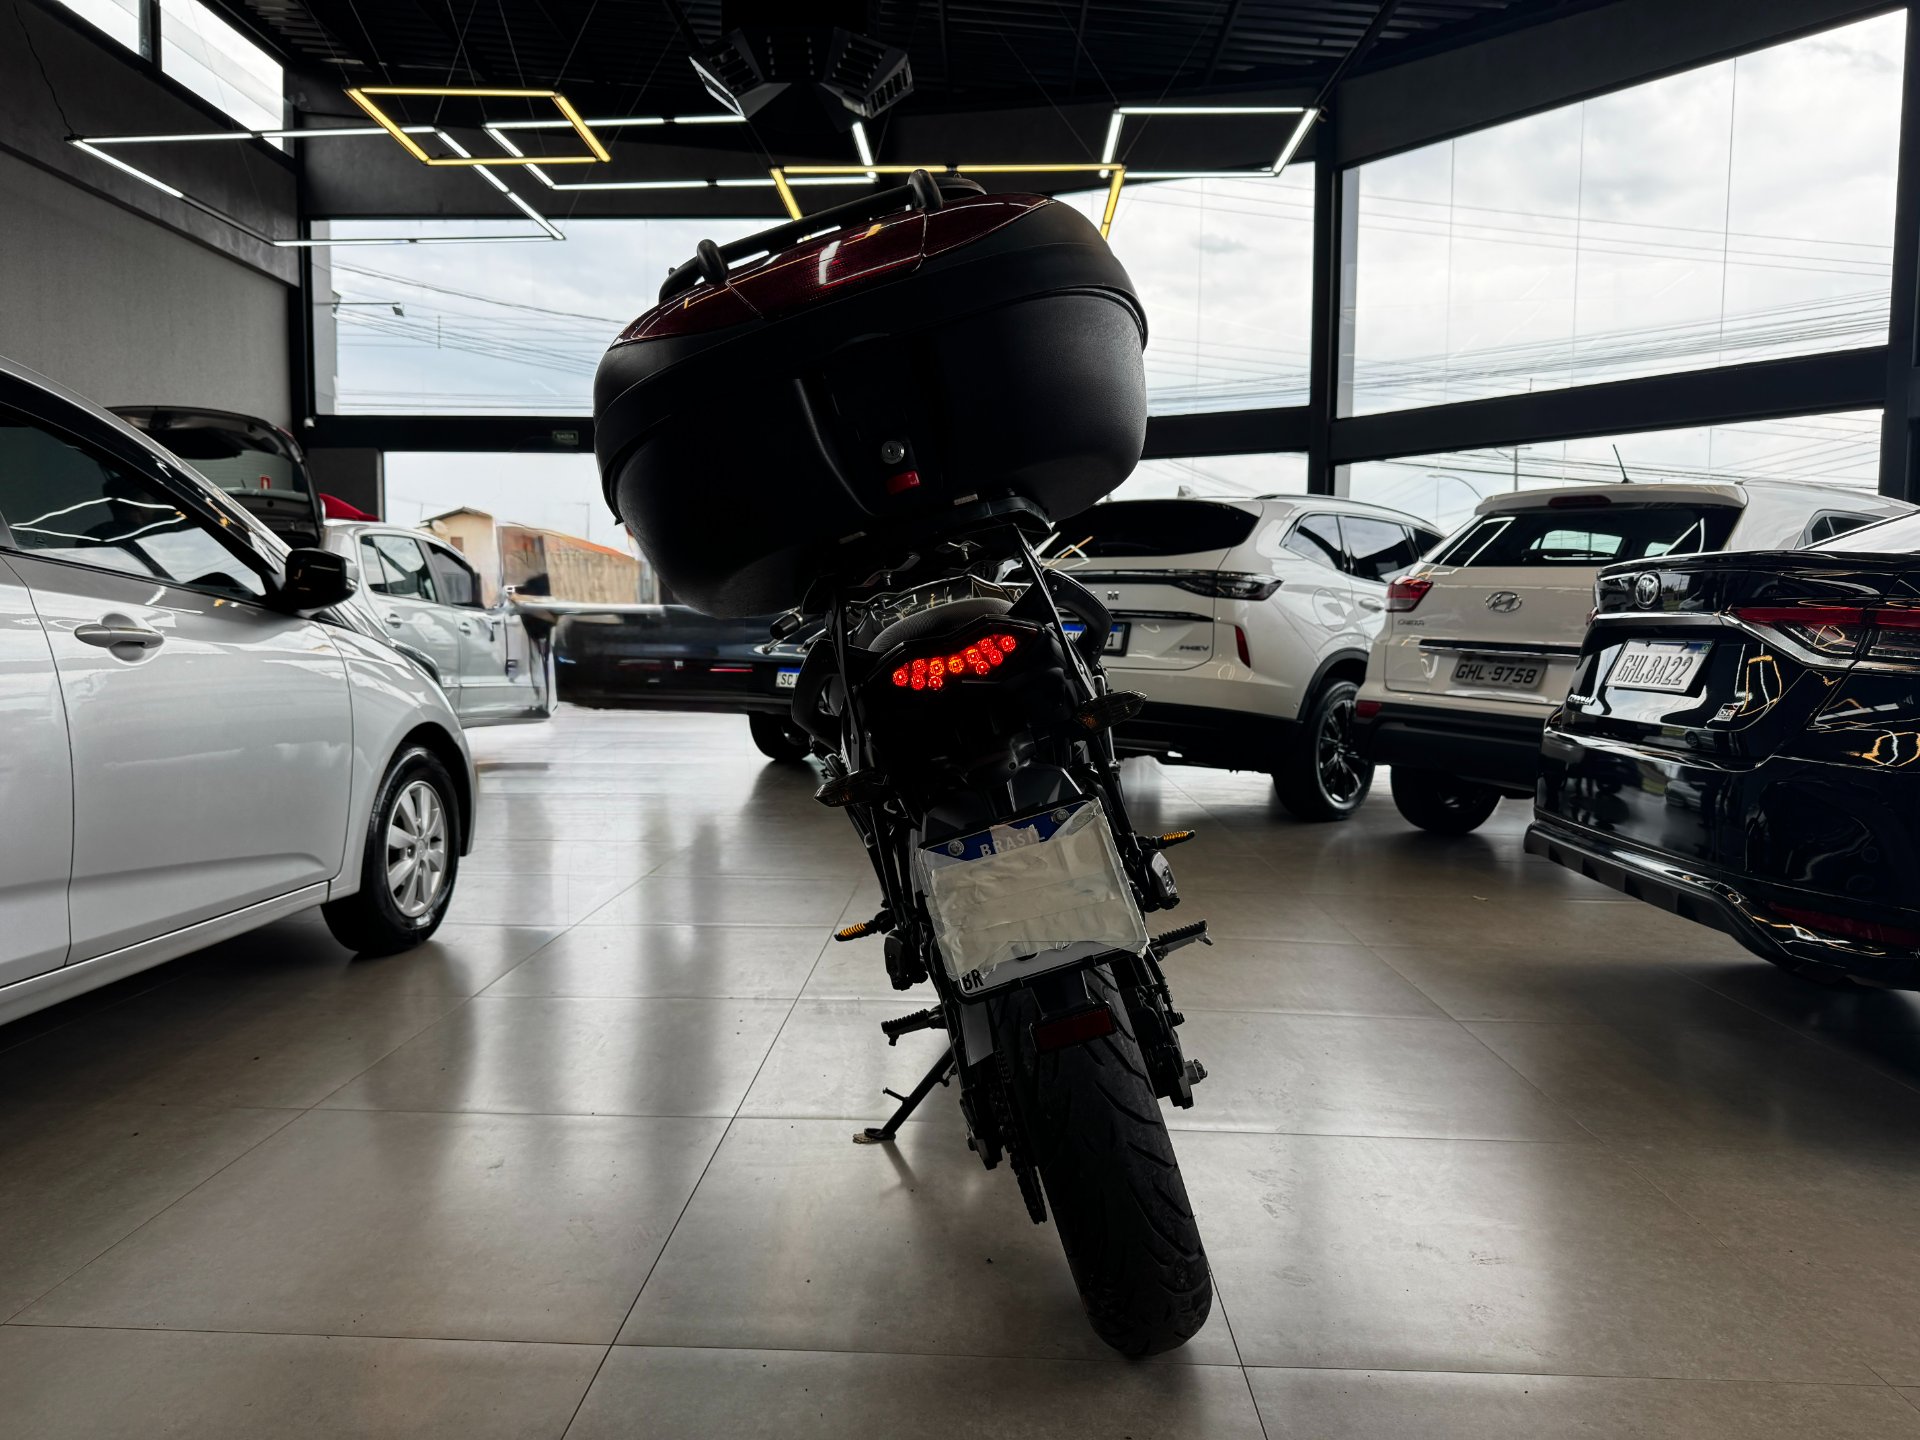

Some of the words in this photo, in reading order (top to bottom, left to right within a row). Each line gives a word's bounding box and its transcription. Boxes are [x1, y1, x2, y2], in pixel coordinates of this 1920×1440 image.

[780, 673, 800, 686] SC
[1614, 654, 1693, 686] GHL8A22
[961, 968, 984, 991] BR
